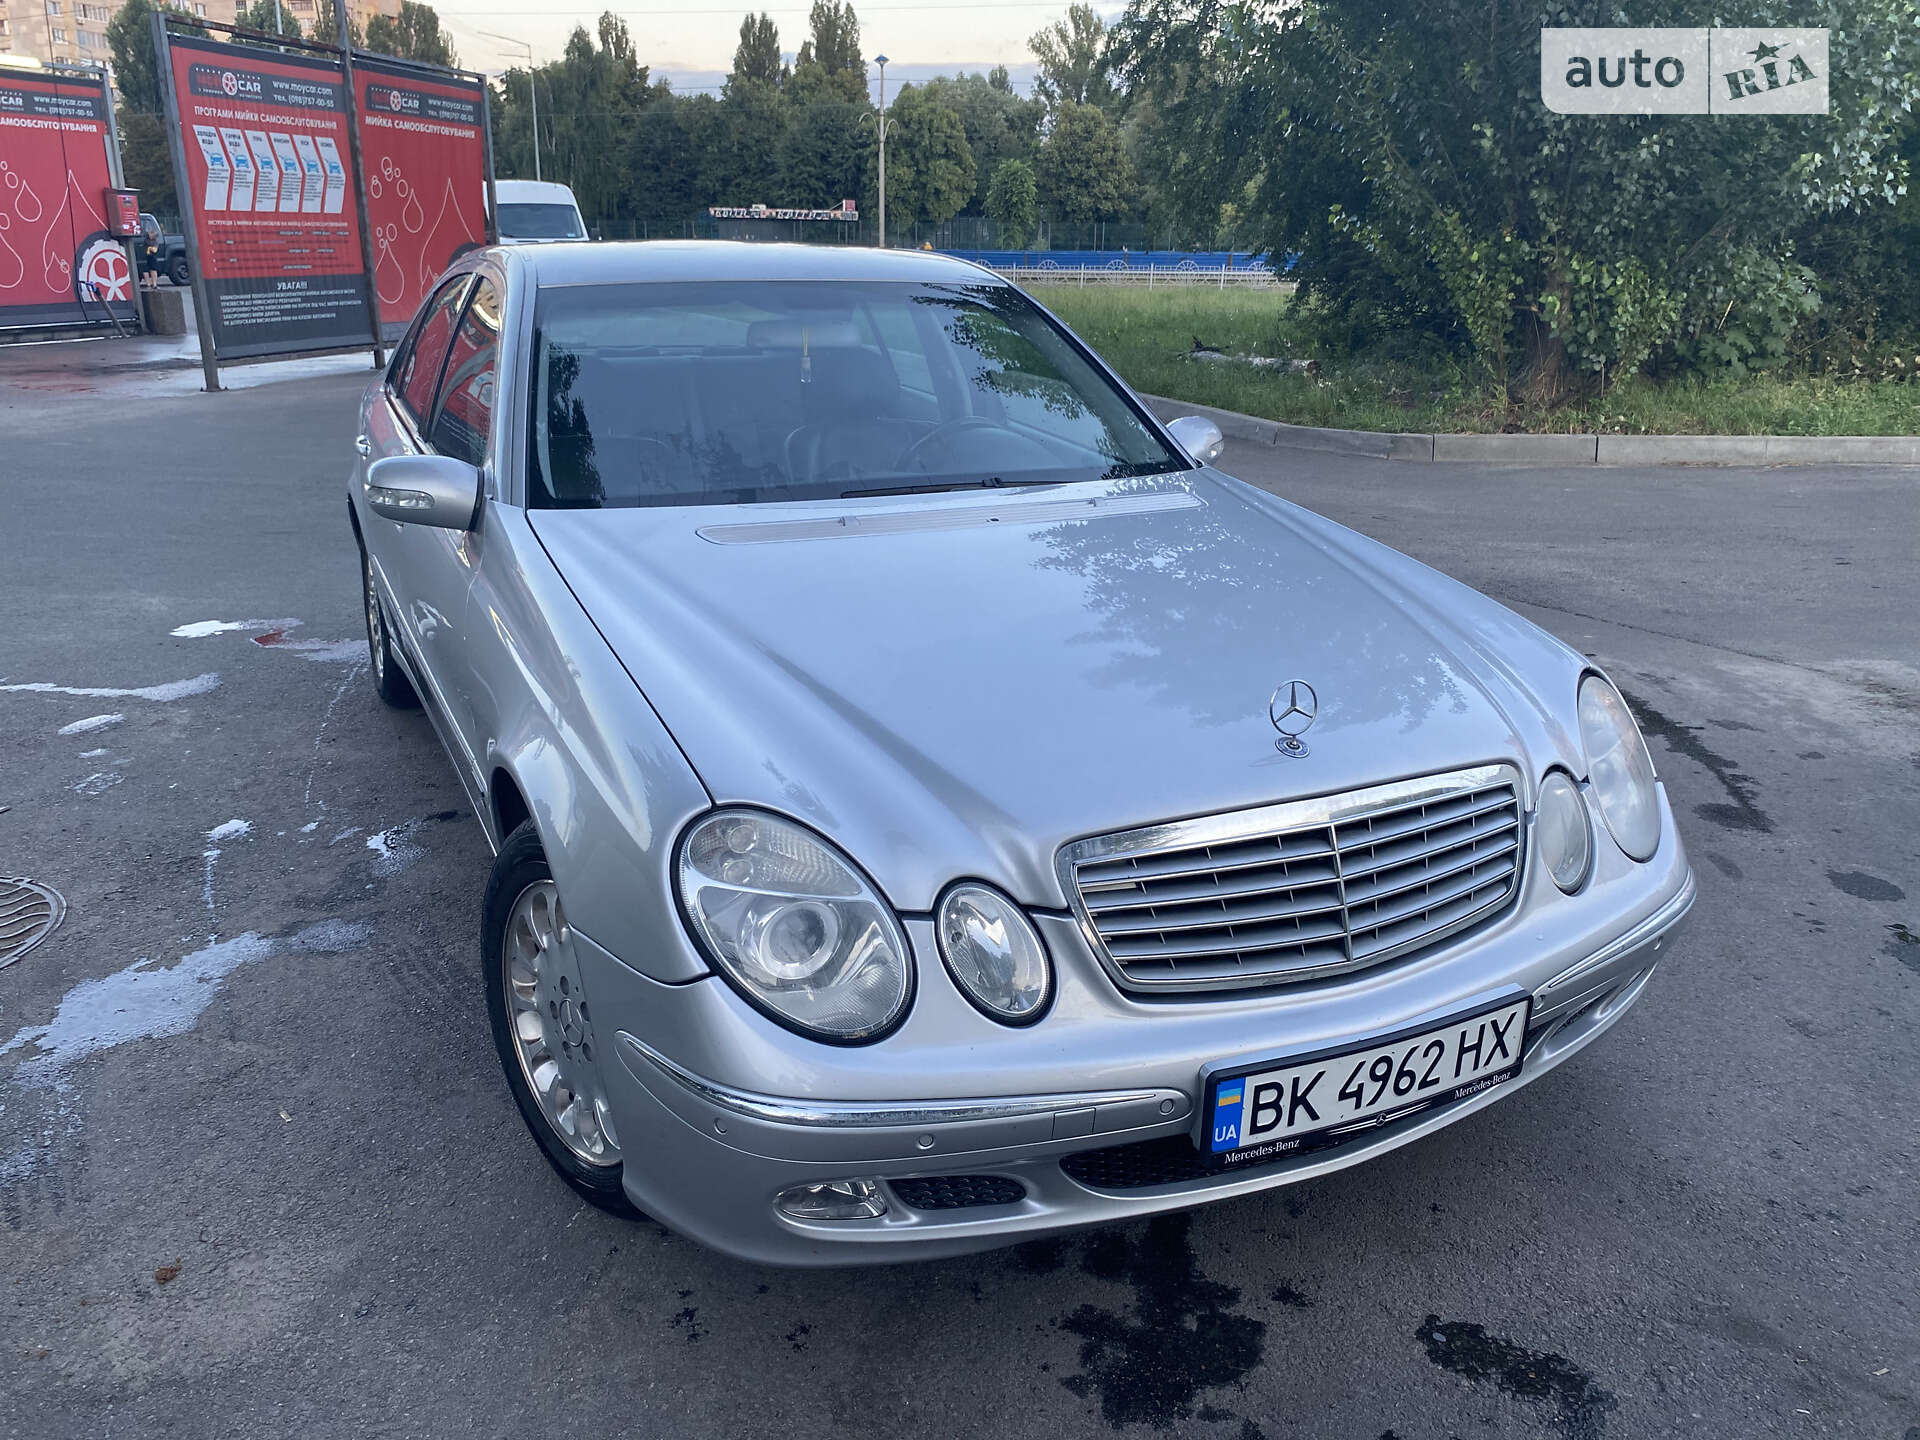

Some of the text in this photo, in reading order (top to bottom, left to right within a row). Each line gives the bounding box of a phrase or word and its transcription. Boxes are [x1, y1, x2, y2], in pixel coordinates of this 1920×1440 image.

[238, 80, 261, 93] CAR
[272, 81, 333, 95] www.moycar.com
[1, 96, 23, 106] CAR
[402, 98, 420, 109] CAR
[194, 105, 233, 120] ПРОГРАМИ
[234, 110, 259, 122] МИЙКИ
[365, 115, 393, 128] МИЙКА
[1249, 1011, 1517, 1136] BK 4962 HX
[1453, 1070, 1511, 1099] Mercedes-Benz
[1214, 1125, 1237, 1143] UA
[1224, 1138, 1300, 1164] Mercedes-Benz
